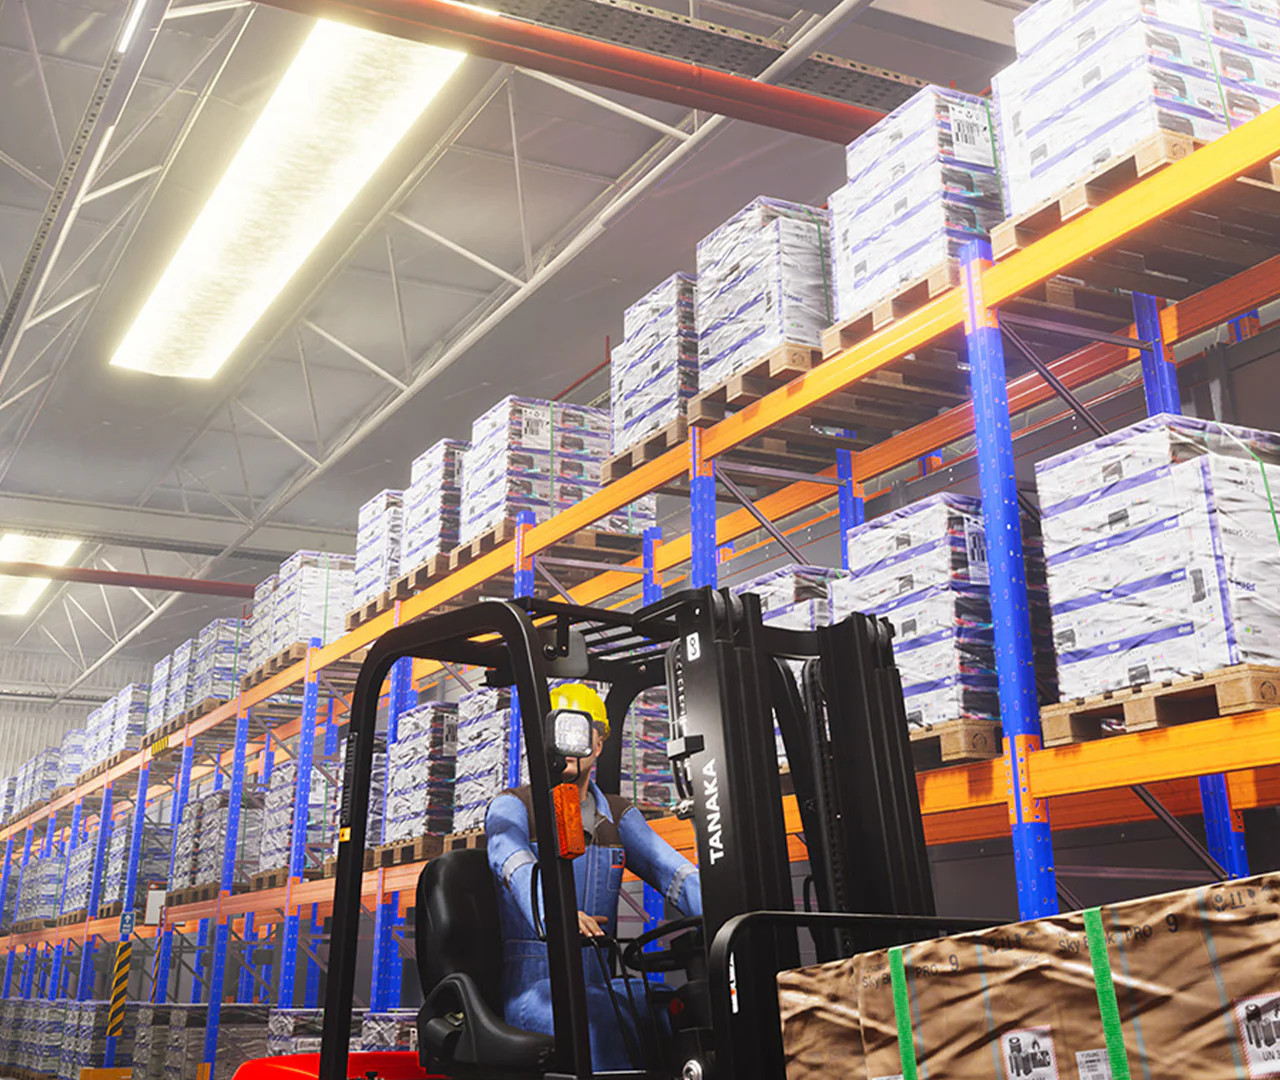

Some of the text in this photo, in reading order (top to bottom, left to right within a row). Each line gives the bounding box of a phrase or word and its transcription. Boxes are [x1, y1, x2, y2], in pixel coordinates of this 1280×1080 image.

[705, 757, 723, 866] TANAKA
[1058, 938, 1081, 955] Sky
[1125, 924, 1153, 942] PRO
[1165, 913, 1179, 933] 9
[862, 974, 881, 990] Sky
[915, 963, 939, 978] PRO
[949, 953, 960, 973] 9
[1262, 1050, 1276, 1062] UN
